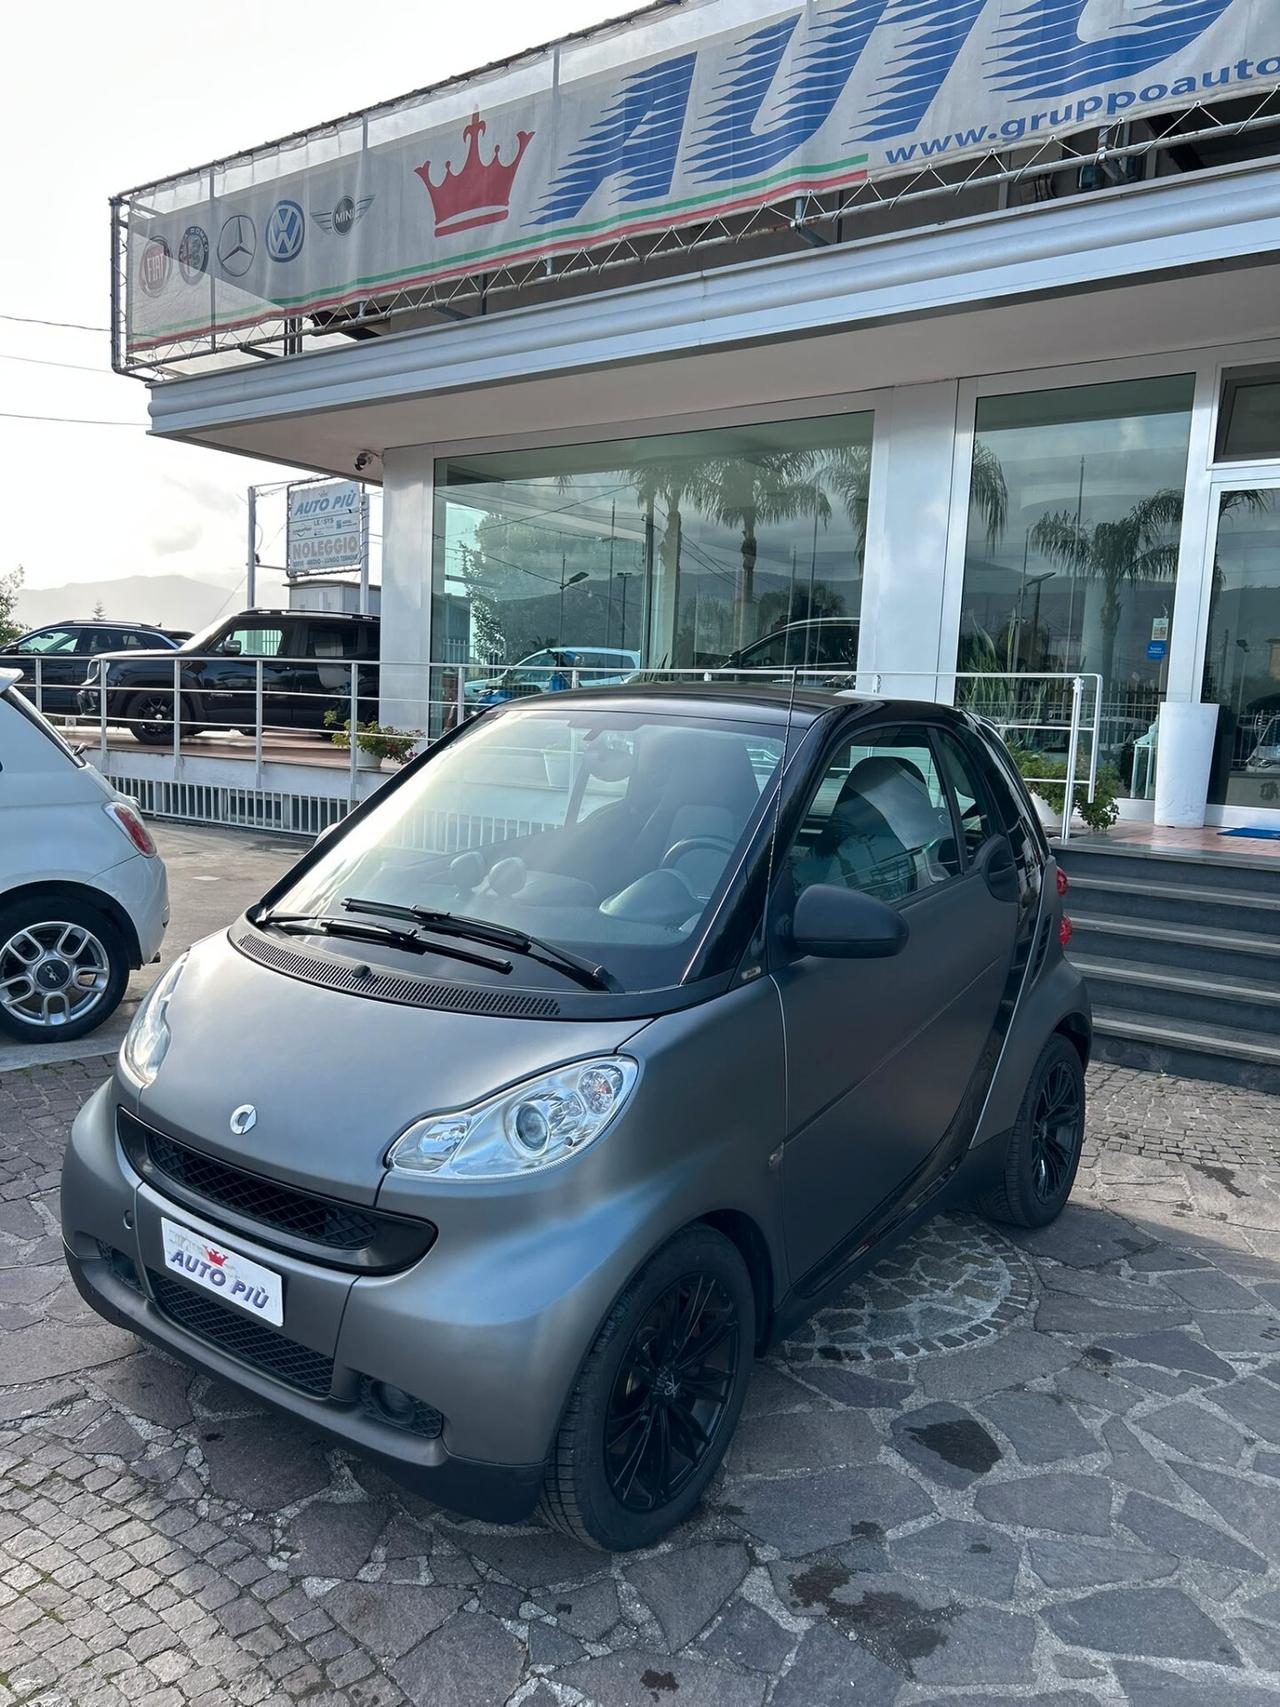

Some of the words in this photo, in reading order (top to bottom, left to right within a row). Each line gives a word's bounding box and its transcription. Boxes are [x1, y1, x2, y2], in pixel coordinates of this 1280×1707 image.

[294, 498, 329, 515] AUTO
[293, 536, 358, 560] NOLEGGIO
[170, 1251, 226, 1286] AUTO
